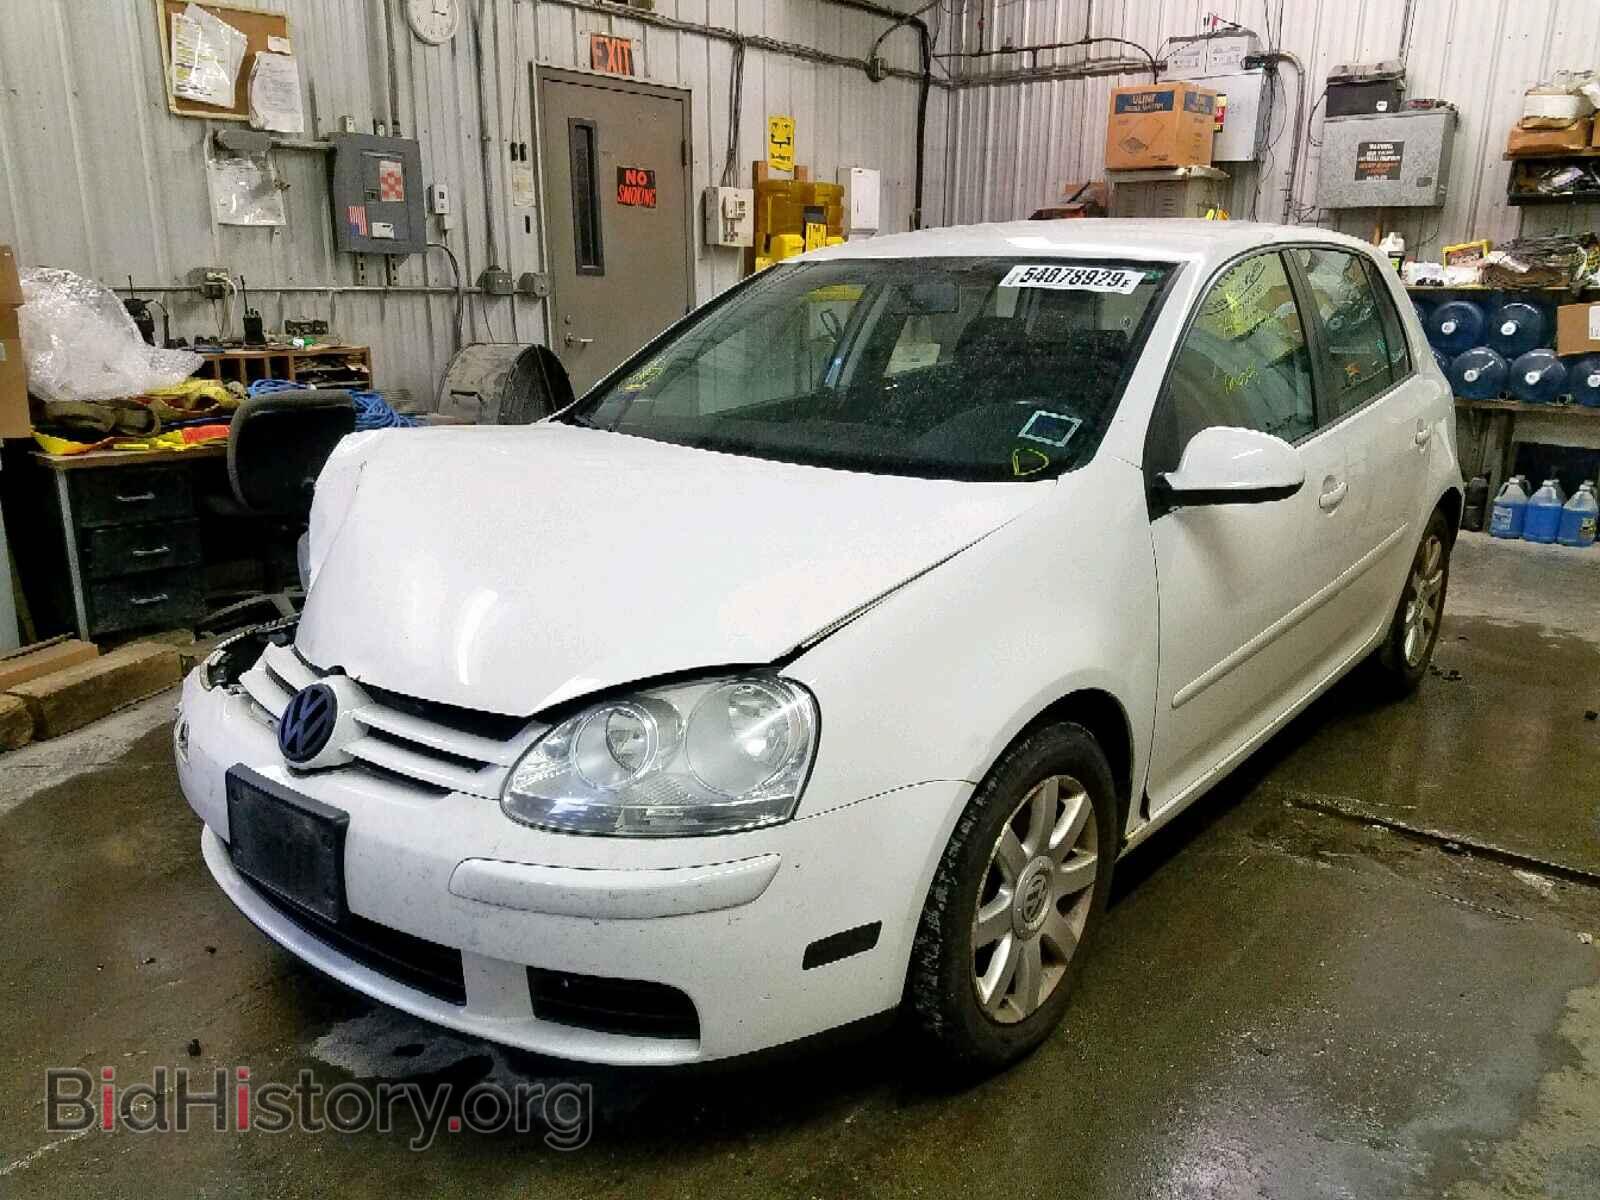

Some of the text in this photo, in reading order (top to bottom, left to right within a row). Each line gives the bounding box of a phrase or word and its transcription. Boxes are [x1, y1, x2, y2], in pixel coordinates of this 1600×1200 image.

[591, 36, 631, 75] EXIT
[625, 169, 647, 186] NO
[617, 184, 656, 207] SMOKING
